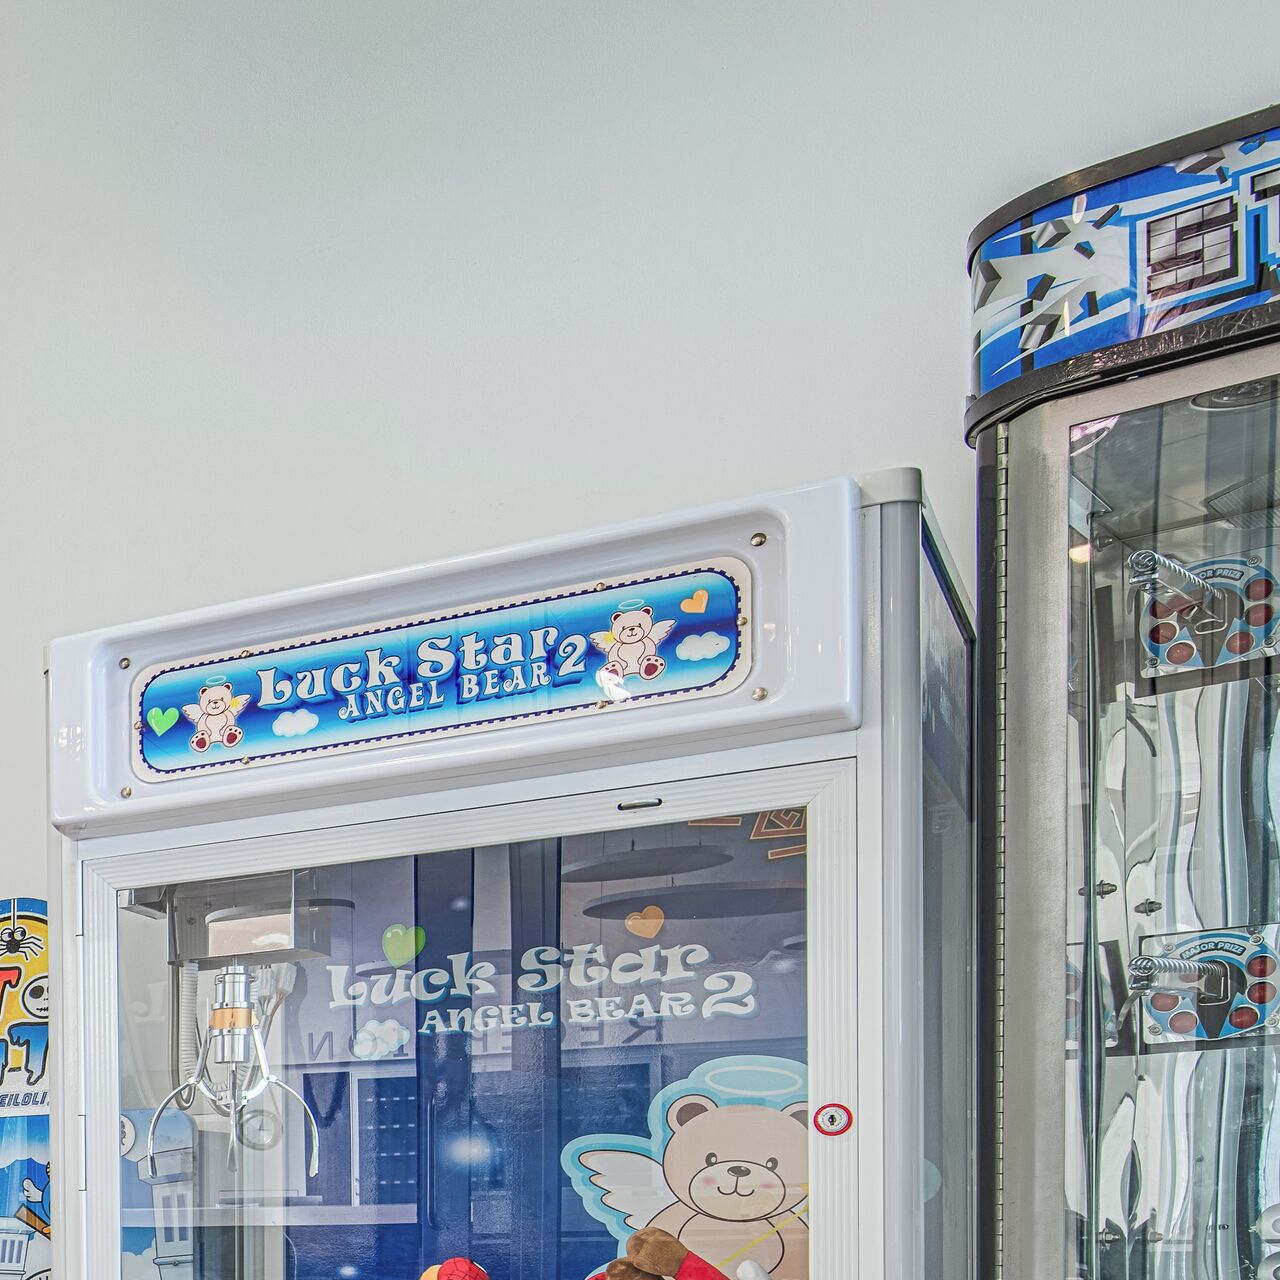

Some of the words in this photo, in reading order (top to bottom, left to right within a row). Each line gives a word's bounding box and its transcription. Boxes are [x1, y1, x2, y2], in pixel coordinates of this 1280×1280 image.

[256, 647, 404, 710] Luck
[417, 625, 560, 675] Star
[556, 633, 589, 677] 2
[337, 681, 445, 723] ANGEL
[457, 662, 554, 708] BEAR
[324, 949, 495, 1010] Luck
[518, 941, 714, 992] Star
[701, 969, 756, 1019] 2
[1182, 942, 1215, 959] MAJOR
[1217, 941, 1244, 955] PRIZE
[418, 1003, 554, 1038] ANGEL
[568, 992, 694, 1026] BEAR
